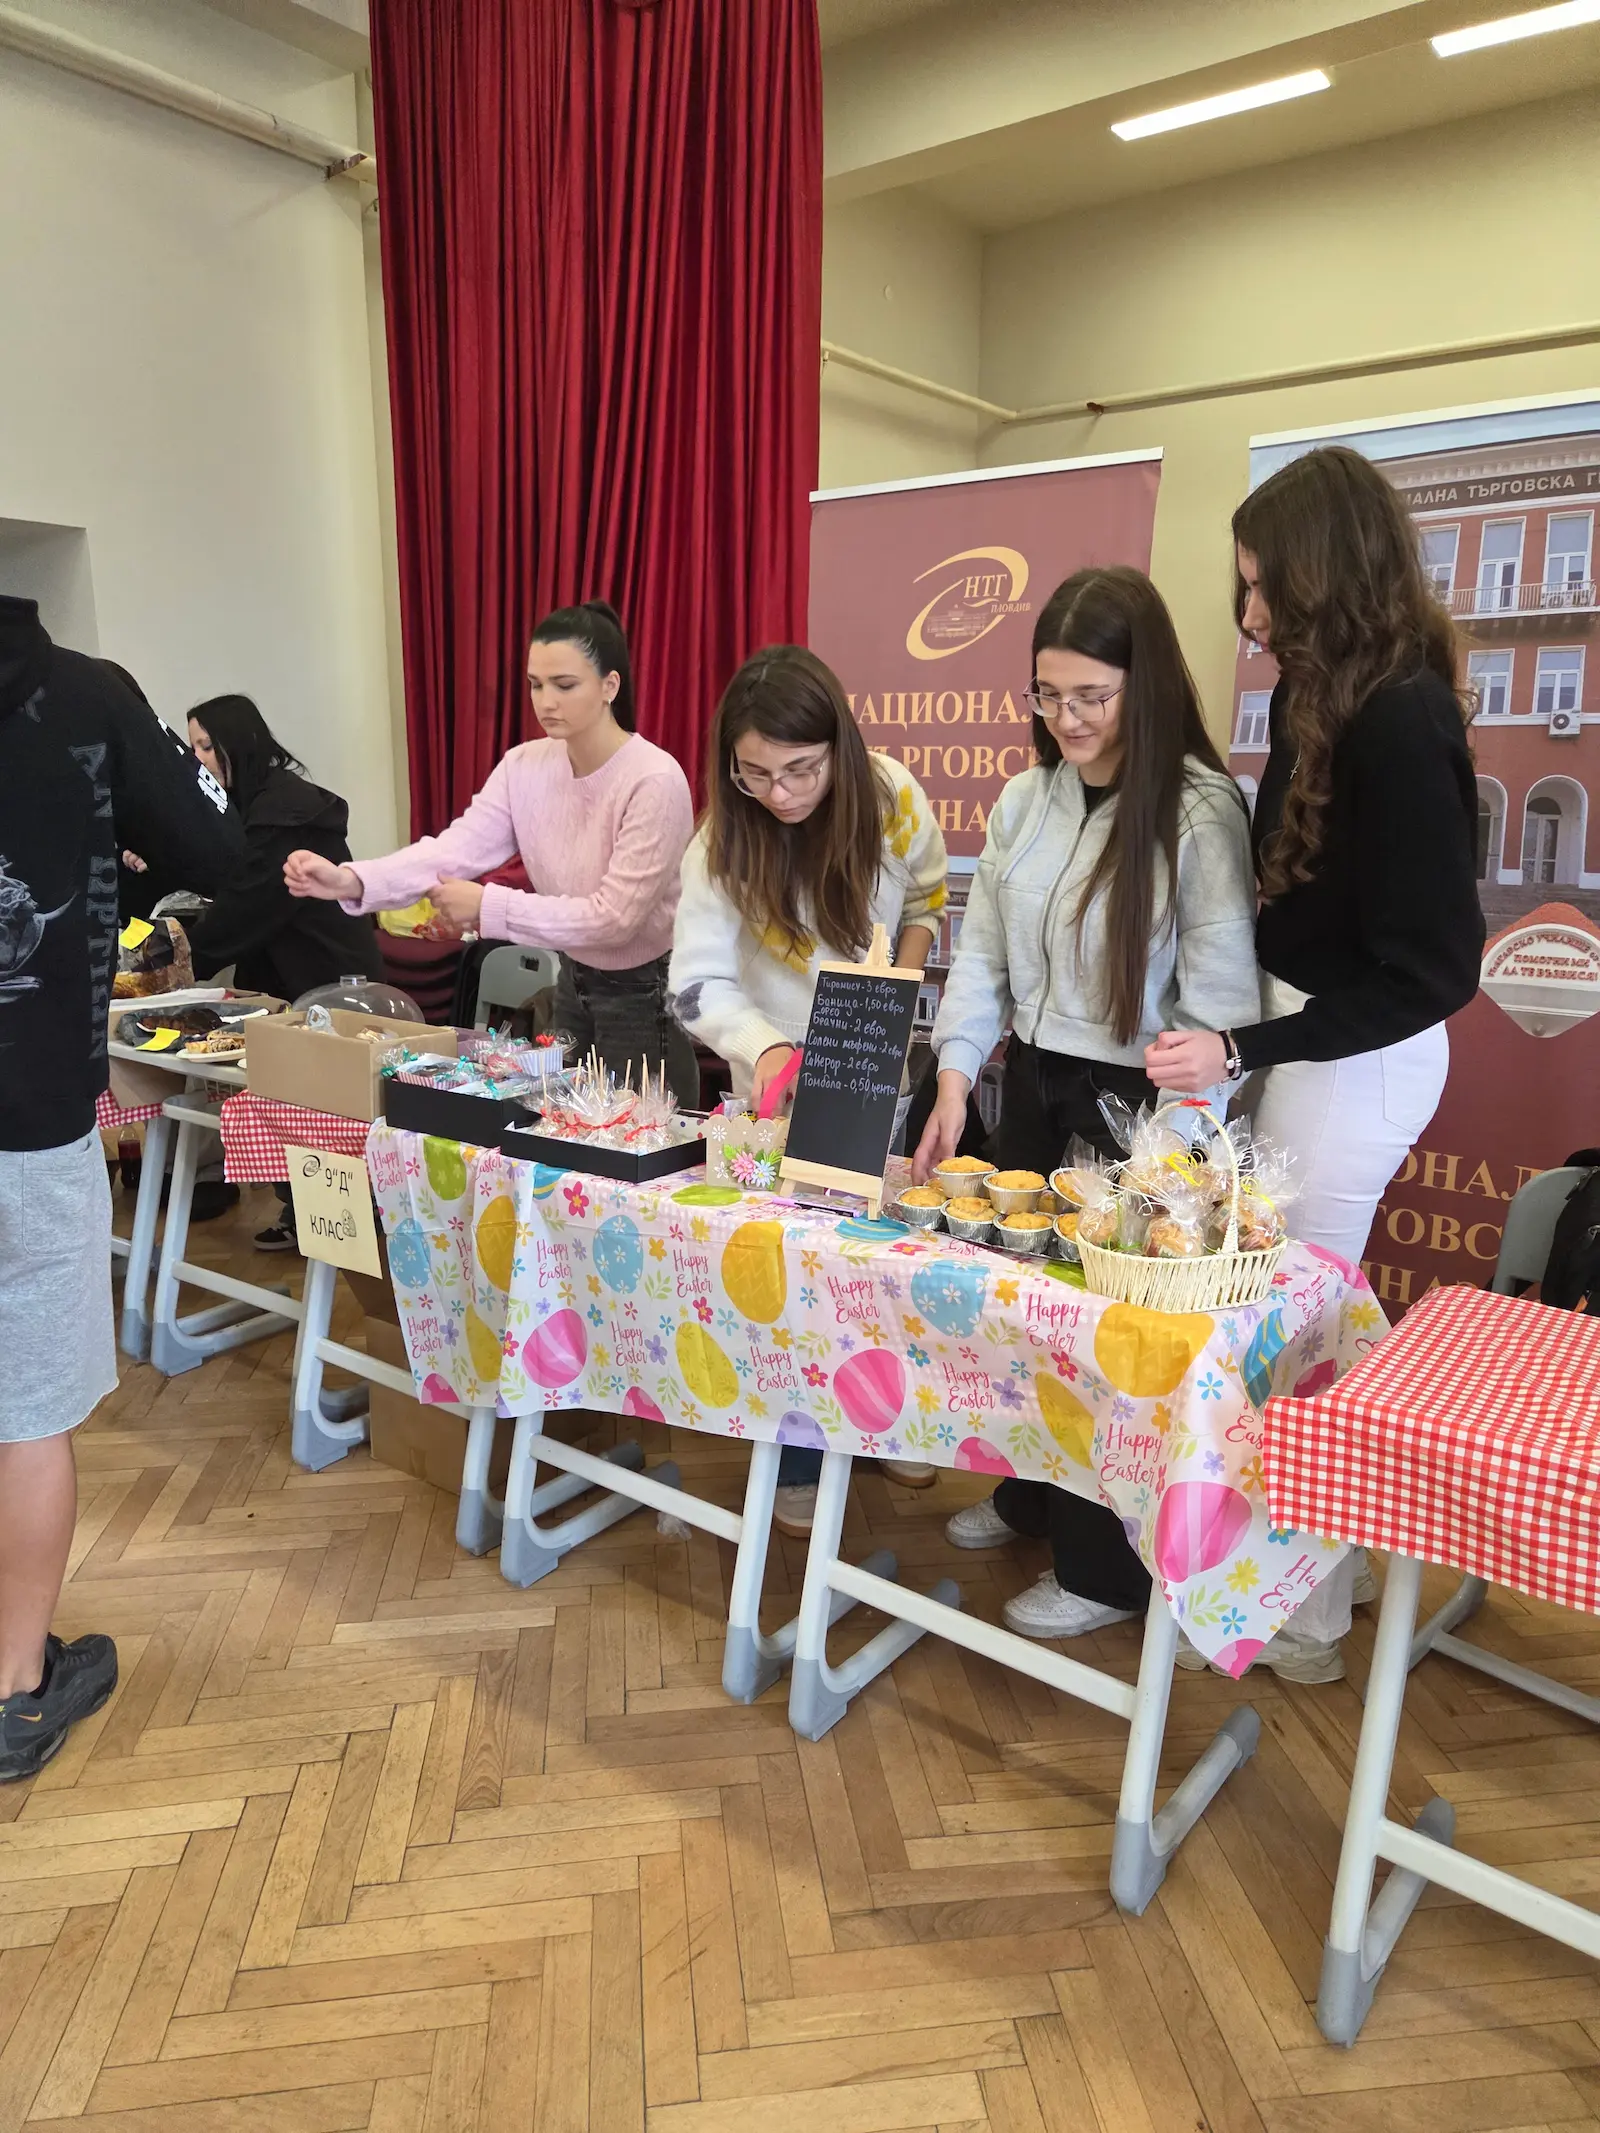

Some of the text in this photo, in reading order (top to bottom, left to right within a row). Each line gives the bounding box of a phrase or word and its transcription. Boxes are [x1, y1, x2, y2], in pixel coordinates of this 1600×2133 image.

[1466, 474, 1576, 499] ТЪРГОВСКА
[963, 573, 1008, 599] НТГ
[990, 602, 1031, 614] ПЛОВДИВ
[801, 1071, 842, 1091] Томбола
[371, 1149, 400, 1171] Happy
[309, 1213, 344, 1242] КЛАС
[536, 1239, 569, 1263] Happy
[672, 1249, 709, 1275] Happy
[538, 1264, 573, 1288] Easter
[675, 1273, 713, 1299] Easter
[827, 1275, 875, 1301] Happy
[835, 1299, 881, 1325] Easter
[1025, 1293, 1084, 1329] Happy
[406, 1315, 439, 1339] Happy
[611, 1320, 644, 1346] Happy
[410, 1335, 444, 1360] Easter
[615, 1343, 648, 1367] Easter
[750, 1345, 793, 1371] Happy
[756, 1369, 799, 1393] Easter
[942, 1361, 990, 1389] Happy
[947, 1385, 997, 1413] Easter
[1105, 1423, 1164, 1463] Happy
[1224, 1414, 1264, 1451] Eas
[1100, 1453, 1157, 1489] Easter
